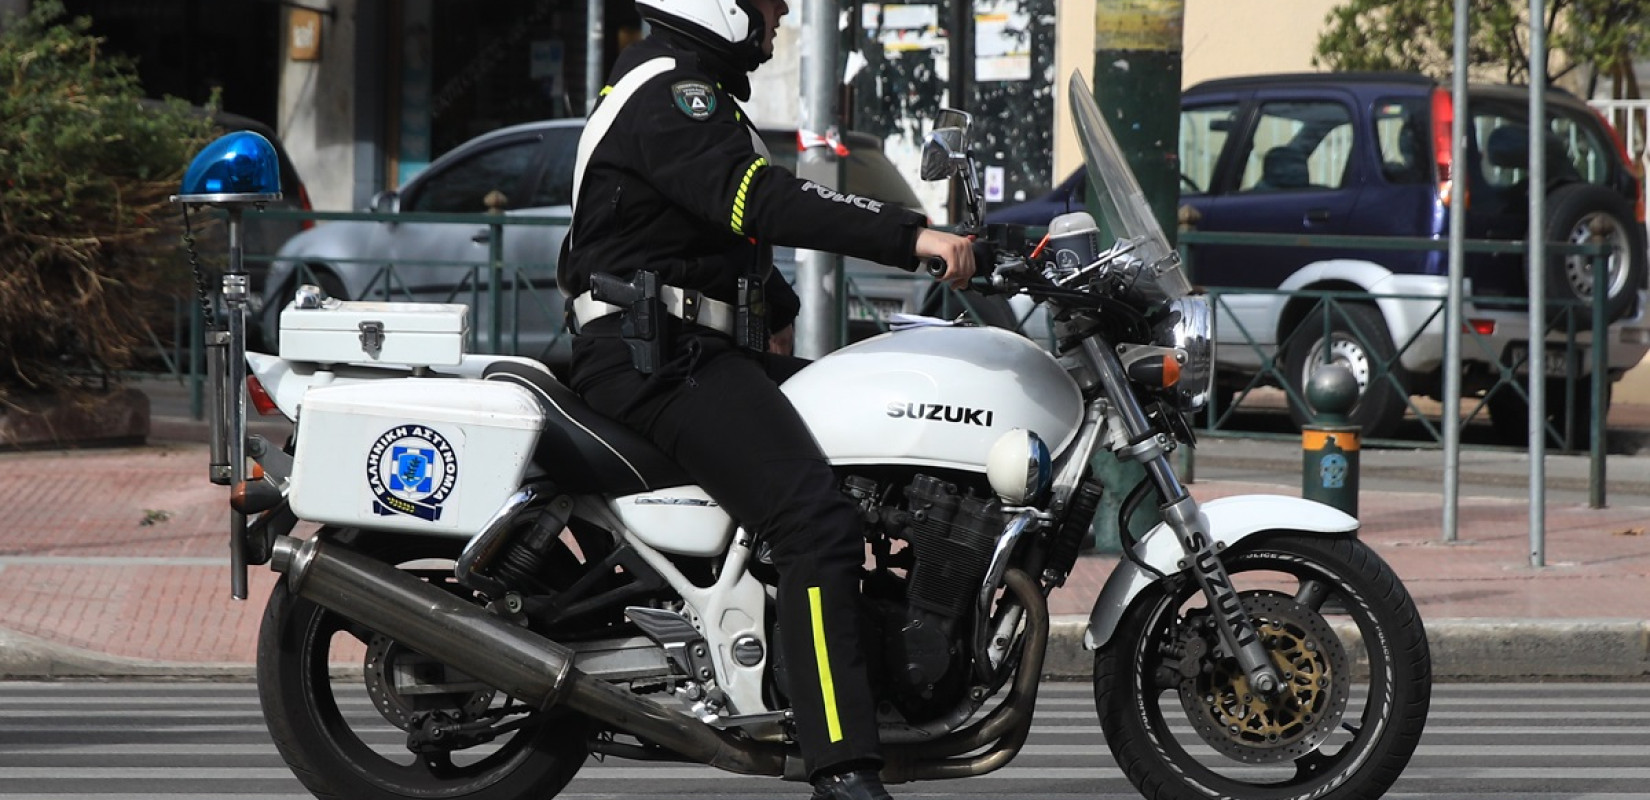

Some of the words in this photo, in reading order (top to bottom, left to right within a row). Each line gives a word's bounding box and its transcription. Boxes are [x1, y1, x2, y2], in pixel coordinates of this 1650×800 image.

[886, 401, 994, 427] SUZUKI
[368, 427, 408, 496] ΕΛΛΗΝΙΚΗ
[412, 427, 456, 500] ΑΣΤΥΝΟΜΙΑ
[1185, 531, 1258, 648] SUZUKI
